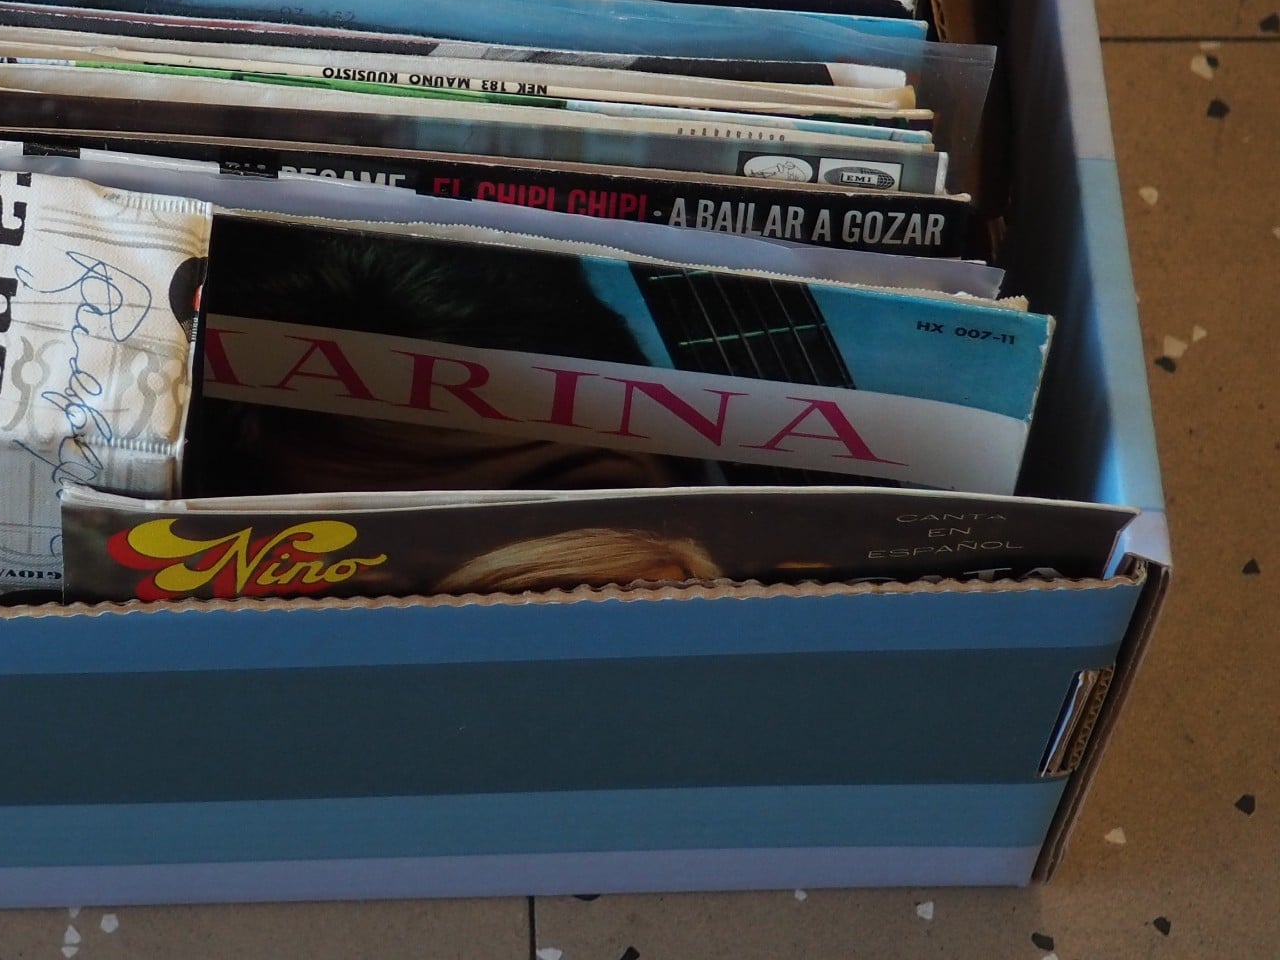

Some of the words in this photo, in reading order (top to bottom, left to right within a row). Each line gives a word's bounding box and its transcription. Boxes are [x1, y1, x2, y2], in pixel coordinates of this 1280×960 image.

[321, 66, 399, 84] KUUSISTO
[409, 73, 471, 89] MAUNO
[481, 79, 507, 92] 183
[517, 82, 548, 95] NEK
[845, 172, 874, 183] EMI
[568, 189, 649, 223] CHIPI
[669, 197, 688, 228] A
[695, 199, 806, 240] BAILAR
[811, 209, 832, 242] A
[841, 209, 946, 247] GOZAR
[915, 320, 945, 335] HX
[954, 326, 1016, 345] 007-11
[895, 512, 1007, 523] CANTA
[927, 527, 971, 538] EN
[125, 517, 389, 594] Nino
[867, 539, 1025, 560] ESPAÑOL
